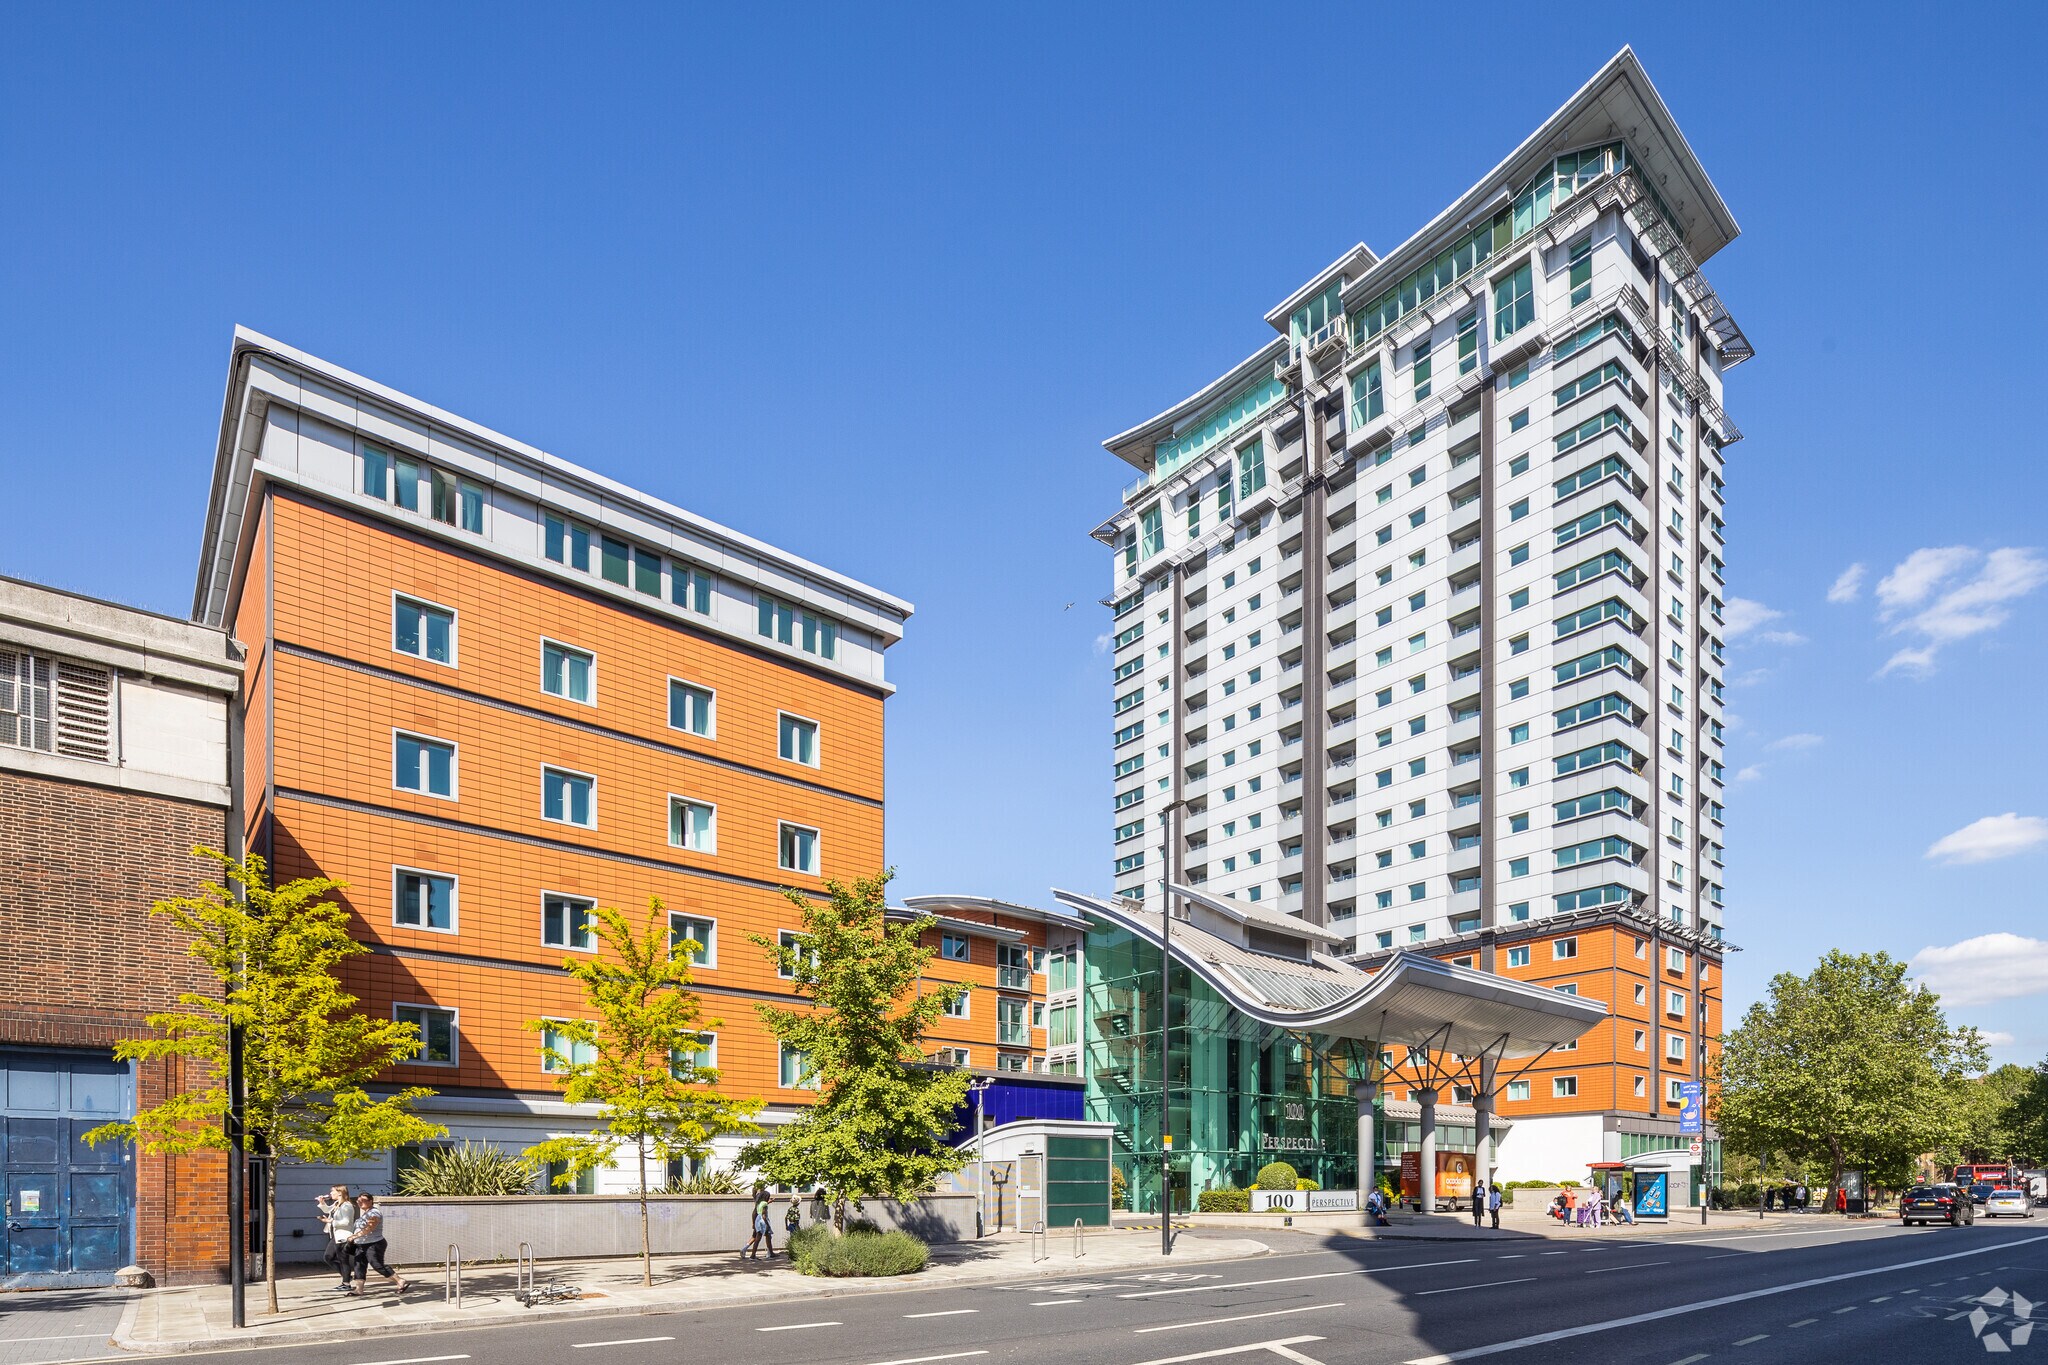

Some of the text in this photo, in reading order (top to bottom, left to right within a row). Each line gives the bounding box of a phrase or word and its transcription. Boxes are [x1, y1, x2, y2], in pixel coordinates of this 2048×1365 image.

[1285, 1102, 1305, 1120] 100
[1262, 1136, 1327, 1150] PERSPECTIE
[1265, 1193, 1294, 1208] 100
[1311, 1198, 1354, 1208] PERSPECTIVE
